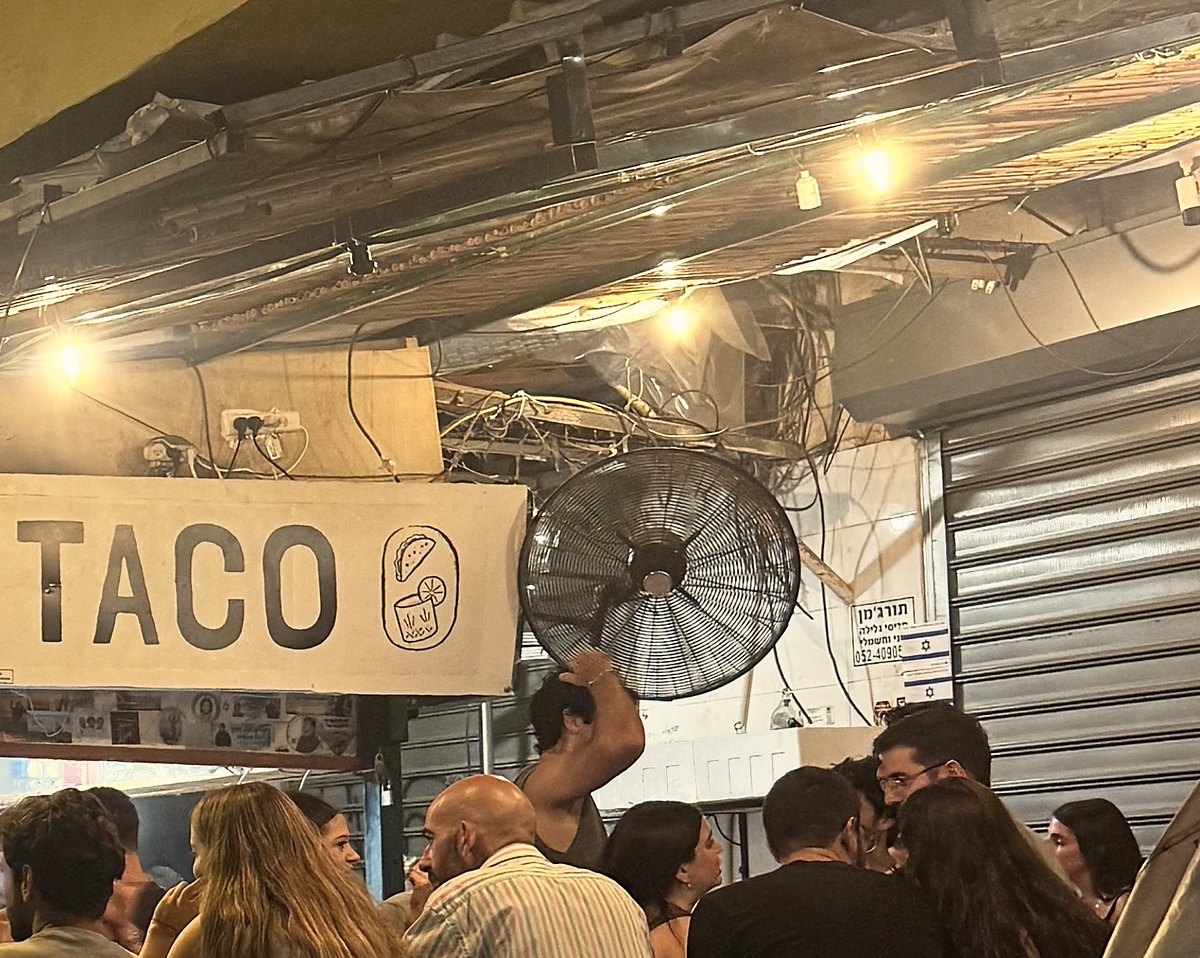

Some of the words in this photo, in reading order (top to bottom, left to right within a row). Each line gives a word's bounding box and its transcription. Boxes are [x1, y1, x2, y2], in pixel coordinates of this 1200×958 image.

[16, 519, 338, 651] TACO
[858, 603, 907, 624] תורג'מן
[859, 624, 883, 635] גלילה
[860, 636, 891, 646] וחשמלי
